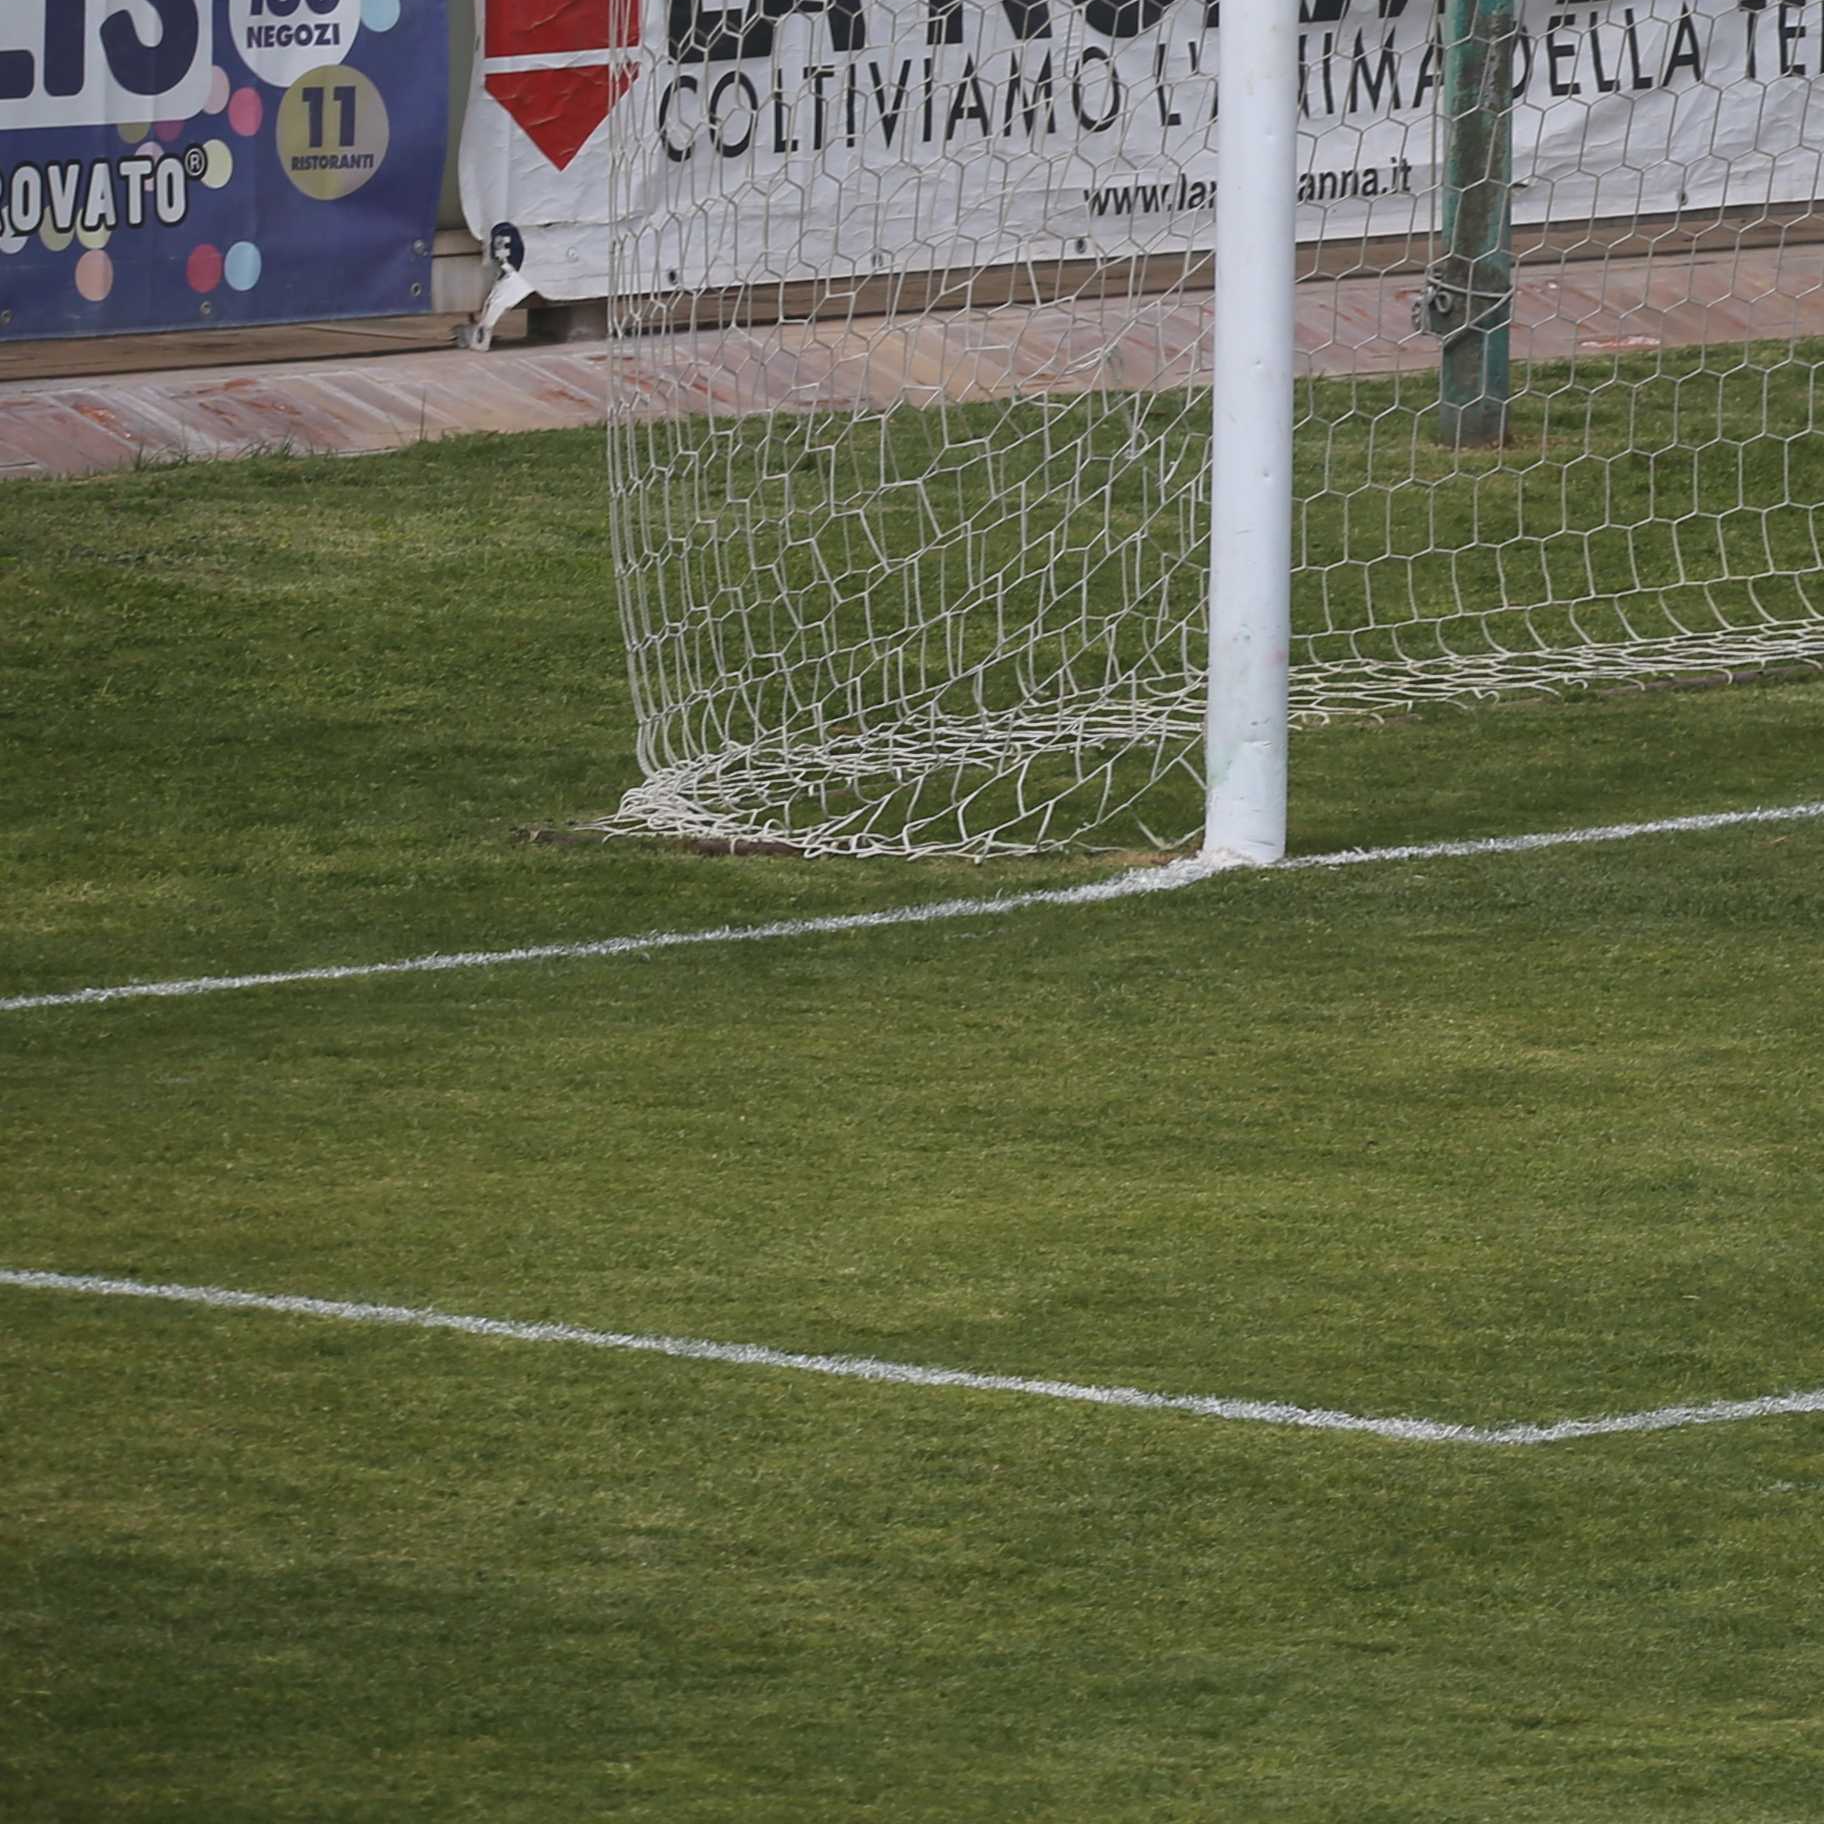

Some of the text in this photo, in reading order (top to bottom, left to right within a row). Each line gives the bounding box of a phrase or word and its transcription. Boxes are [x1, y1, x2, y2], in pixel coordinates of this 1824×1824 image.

[247, 22, 340, 49] NEGOZI
[302, 85, 357, 149] 11
[658, 45, 1120, 162] COLTIVIAMO
[291, 153, 375, 172] RISTORANTI
